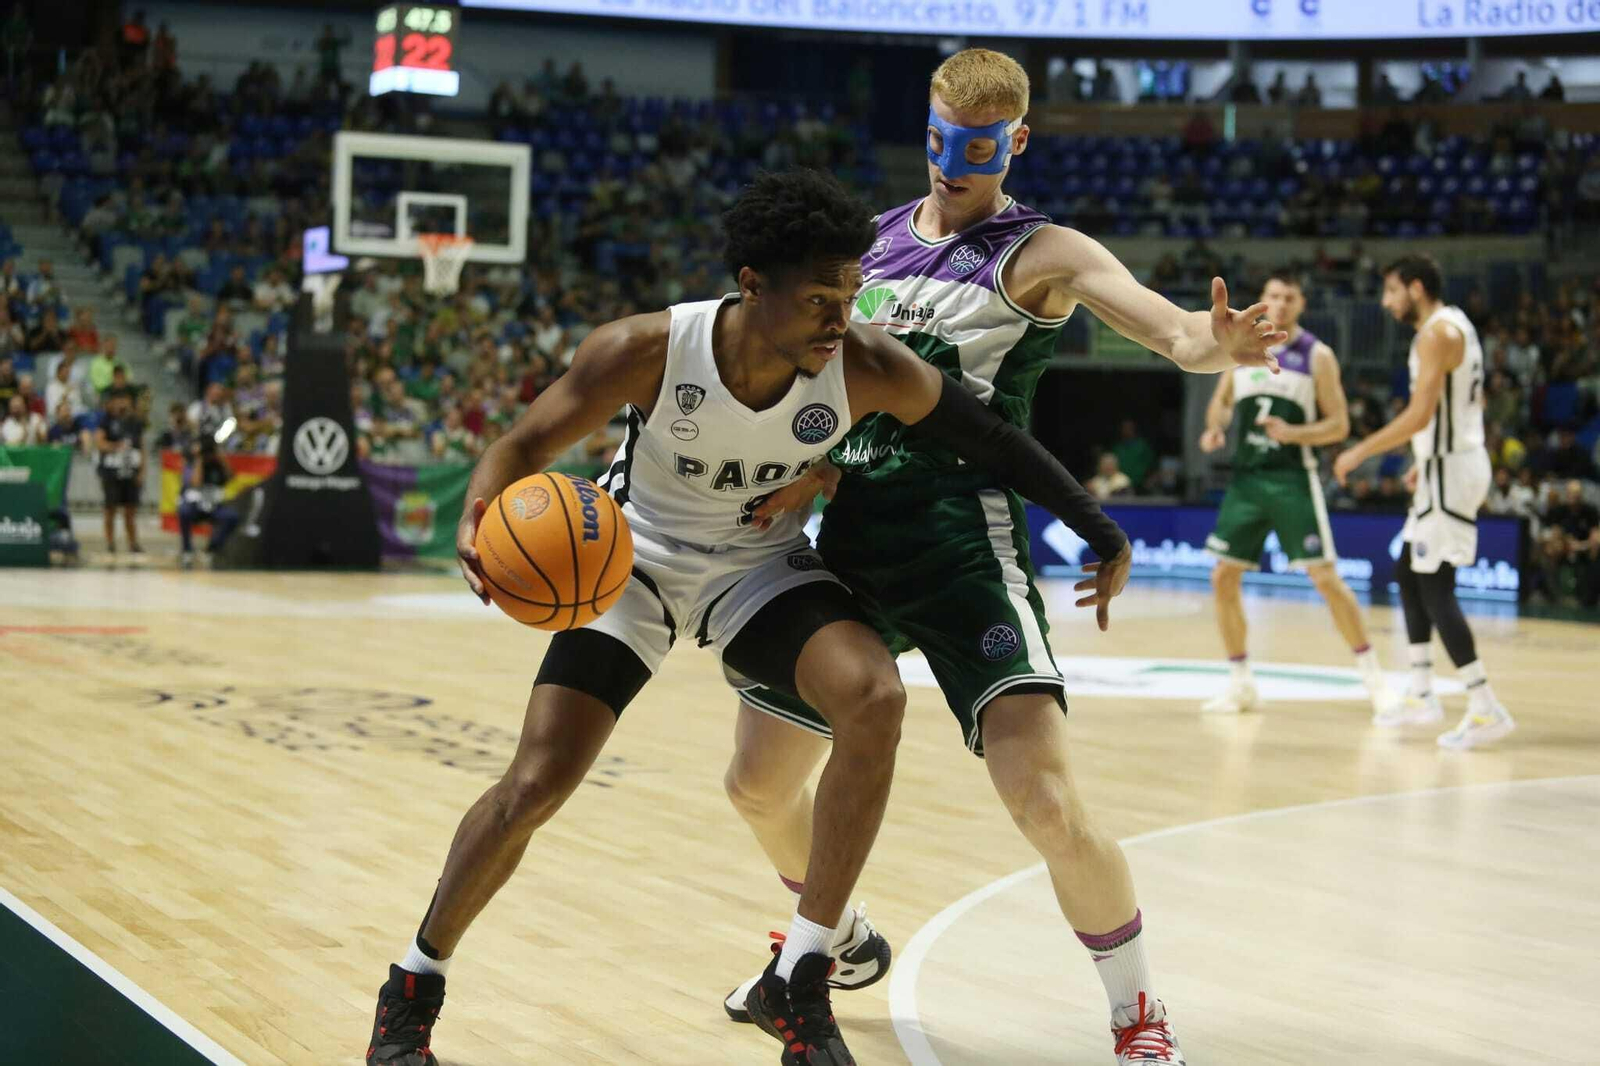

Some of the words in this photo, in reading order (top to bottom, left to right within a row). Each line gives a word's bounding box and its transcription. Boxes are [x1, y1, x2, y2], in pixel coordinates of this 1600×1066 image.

[1418, 0, 1453, 28] La
[1464, 0, 1556, 26] Radio
[402, 32, 452, 71] 22
